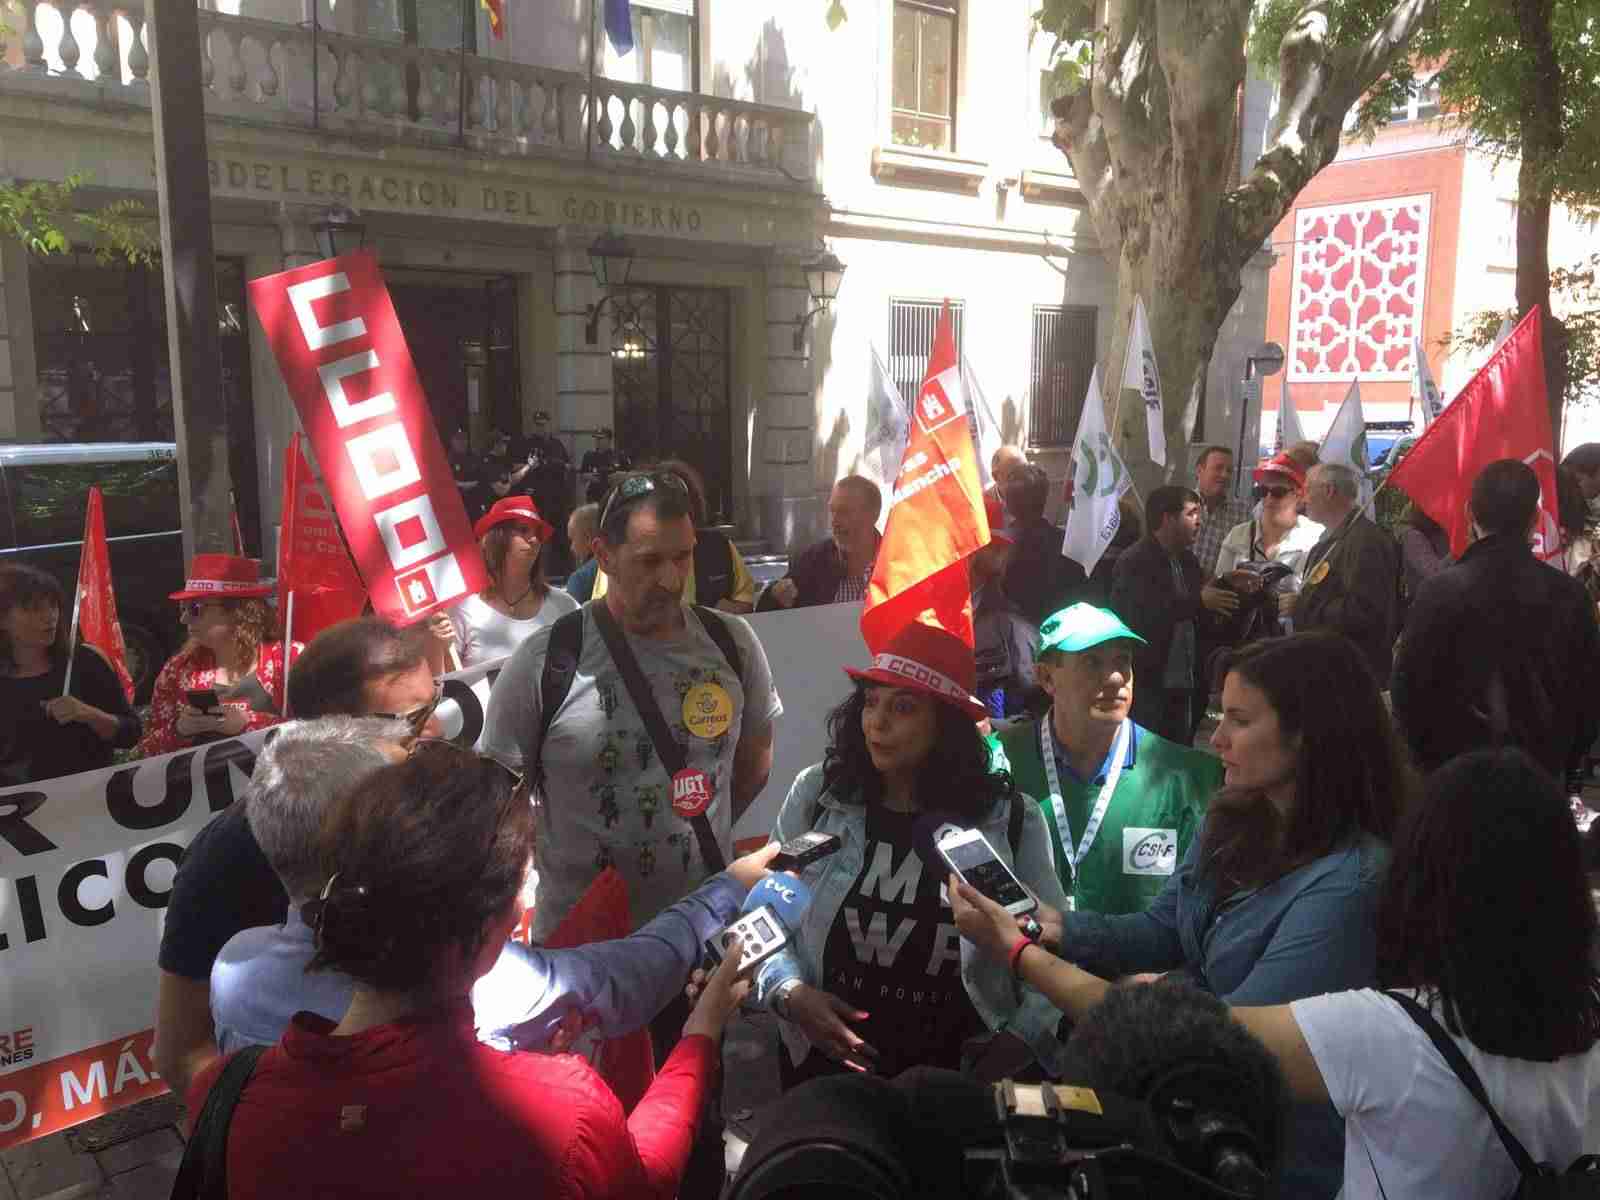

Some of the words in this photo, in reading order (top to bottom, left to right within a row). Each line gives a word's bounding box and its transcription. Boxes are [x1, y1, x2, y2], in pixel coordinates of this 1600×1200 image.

[482, 186, 543, 217] DEL
[562, 193, 702, 233] GOBIERNO
[674, 774, 706, 799] UGT
[837, 972, 863, 990] AN
[59, 1039, 161, 1112] MÁ
